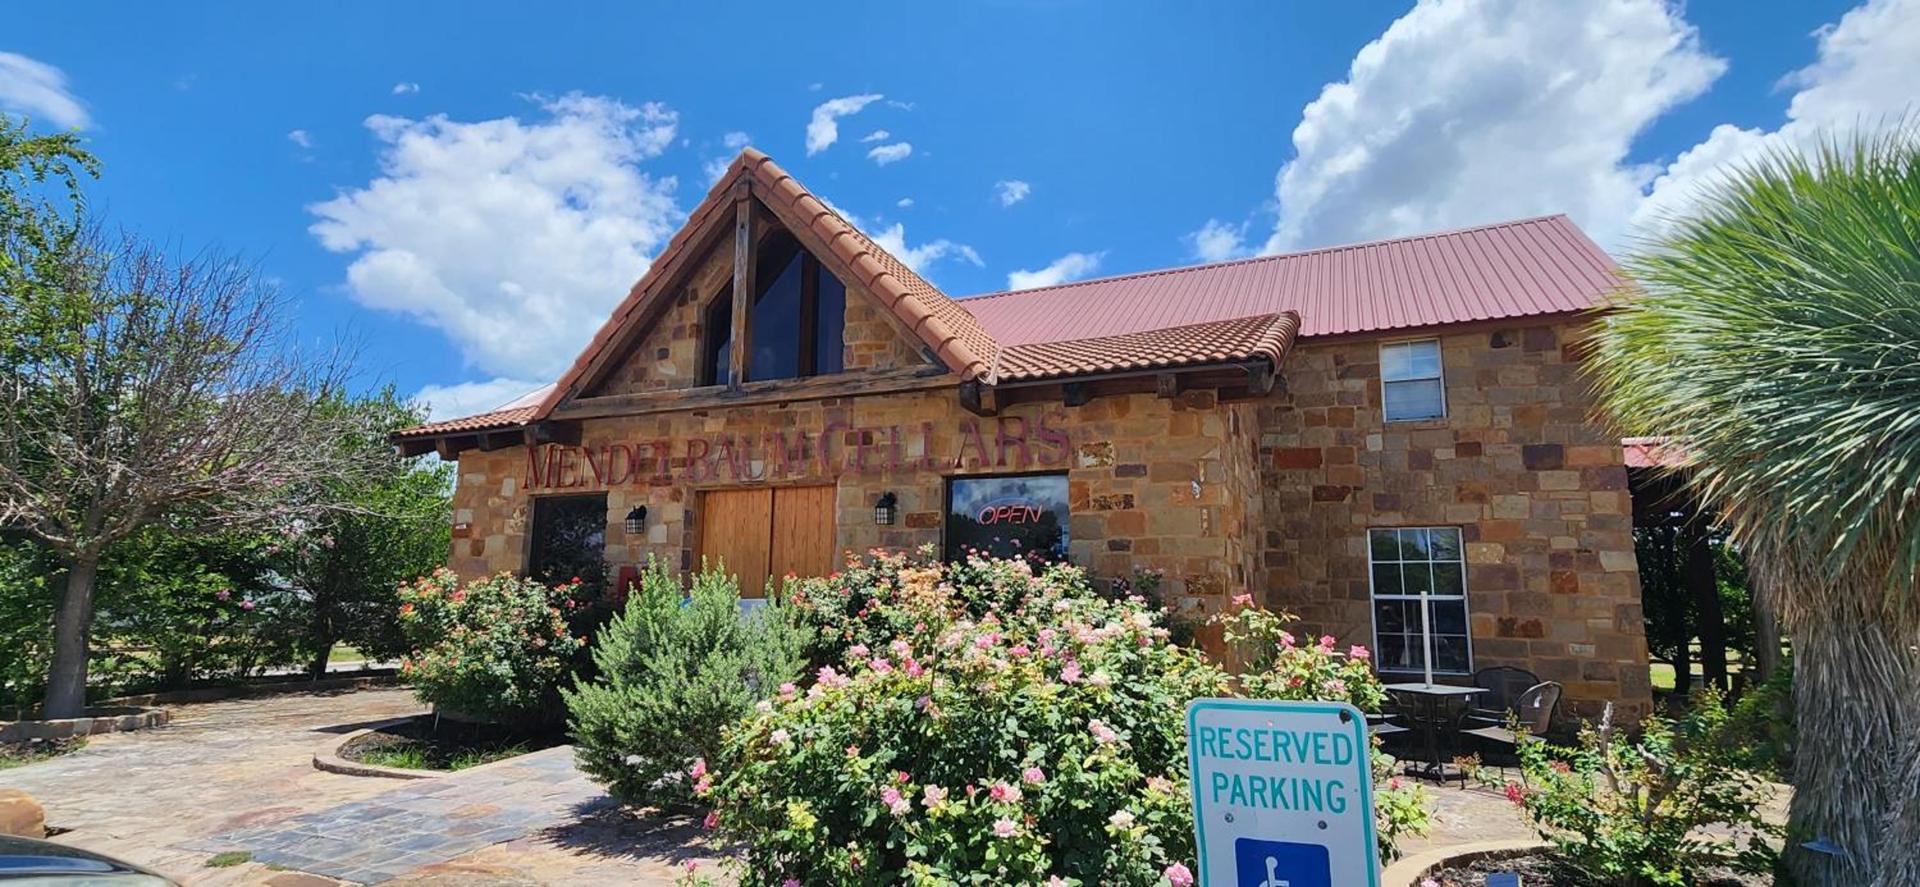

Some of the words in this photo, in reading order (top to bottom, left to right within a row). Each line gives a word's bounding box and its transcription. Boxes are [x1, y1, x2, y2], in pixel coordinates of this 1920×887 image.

[522, 430, 807, 489] MENDELBAUM
[819, 407, 1070, 473] CELLARS
[978, 504, 1043, 525] OPEN
[1200, 726, 1353, 766] RESERVED
[1212, 771, 1346, 814] PARKING
